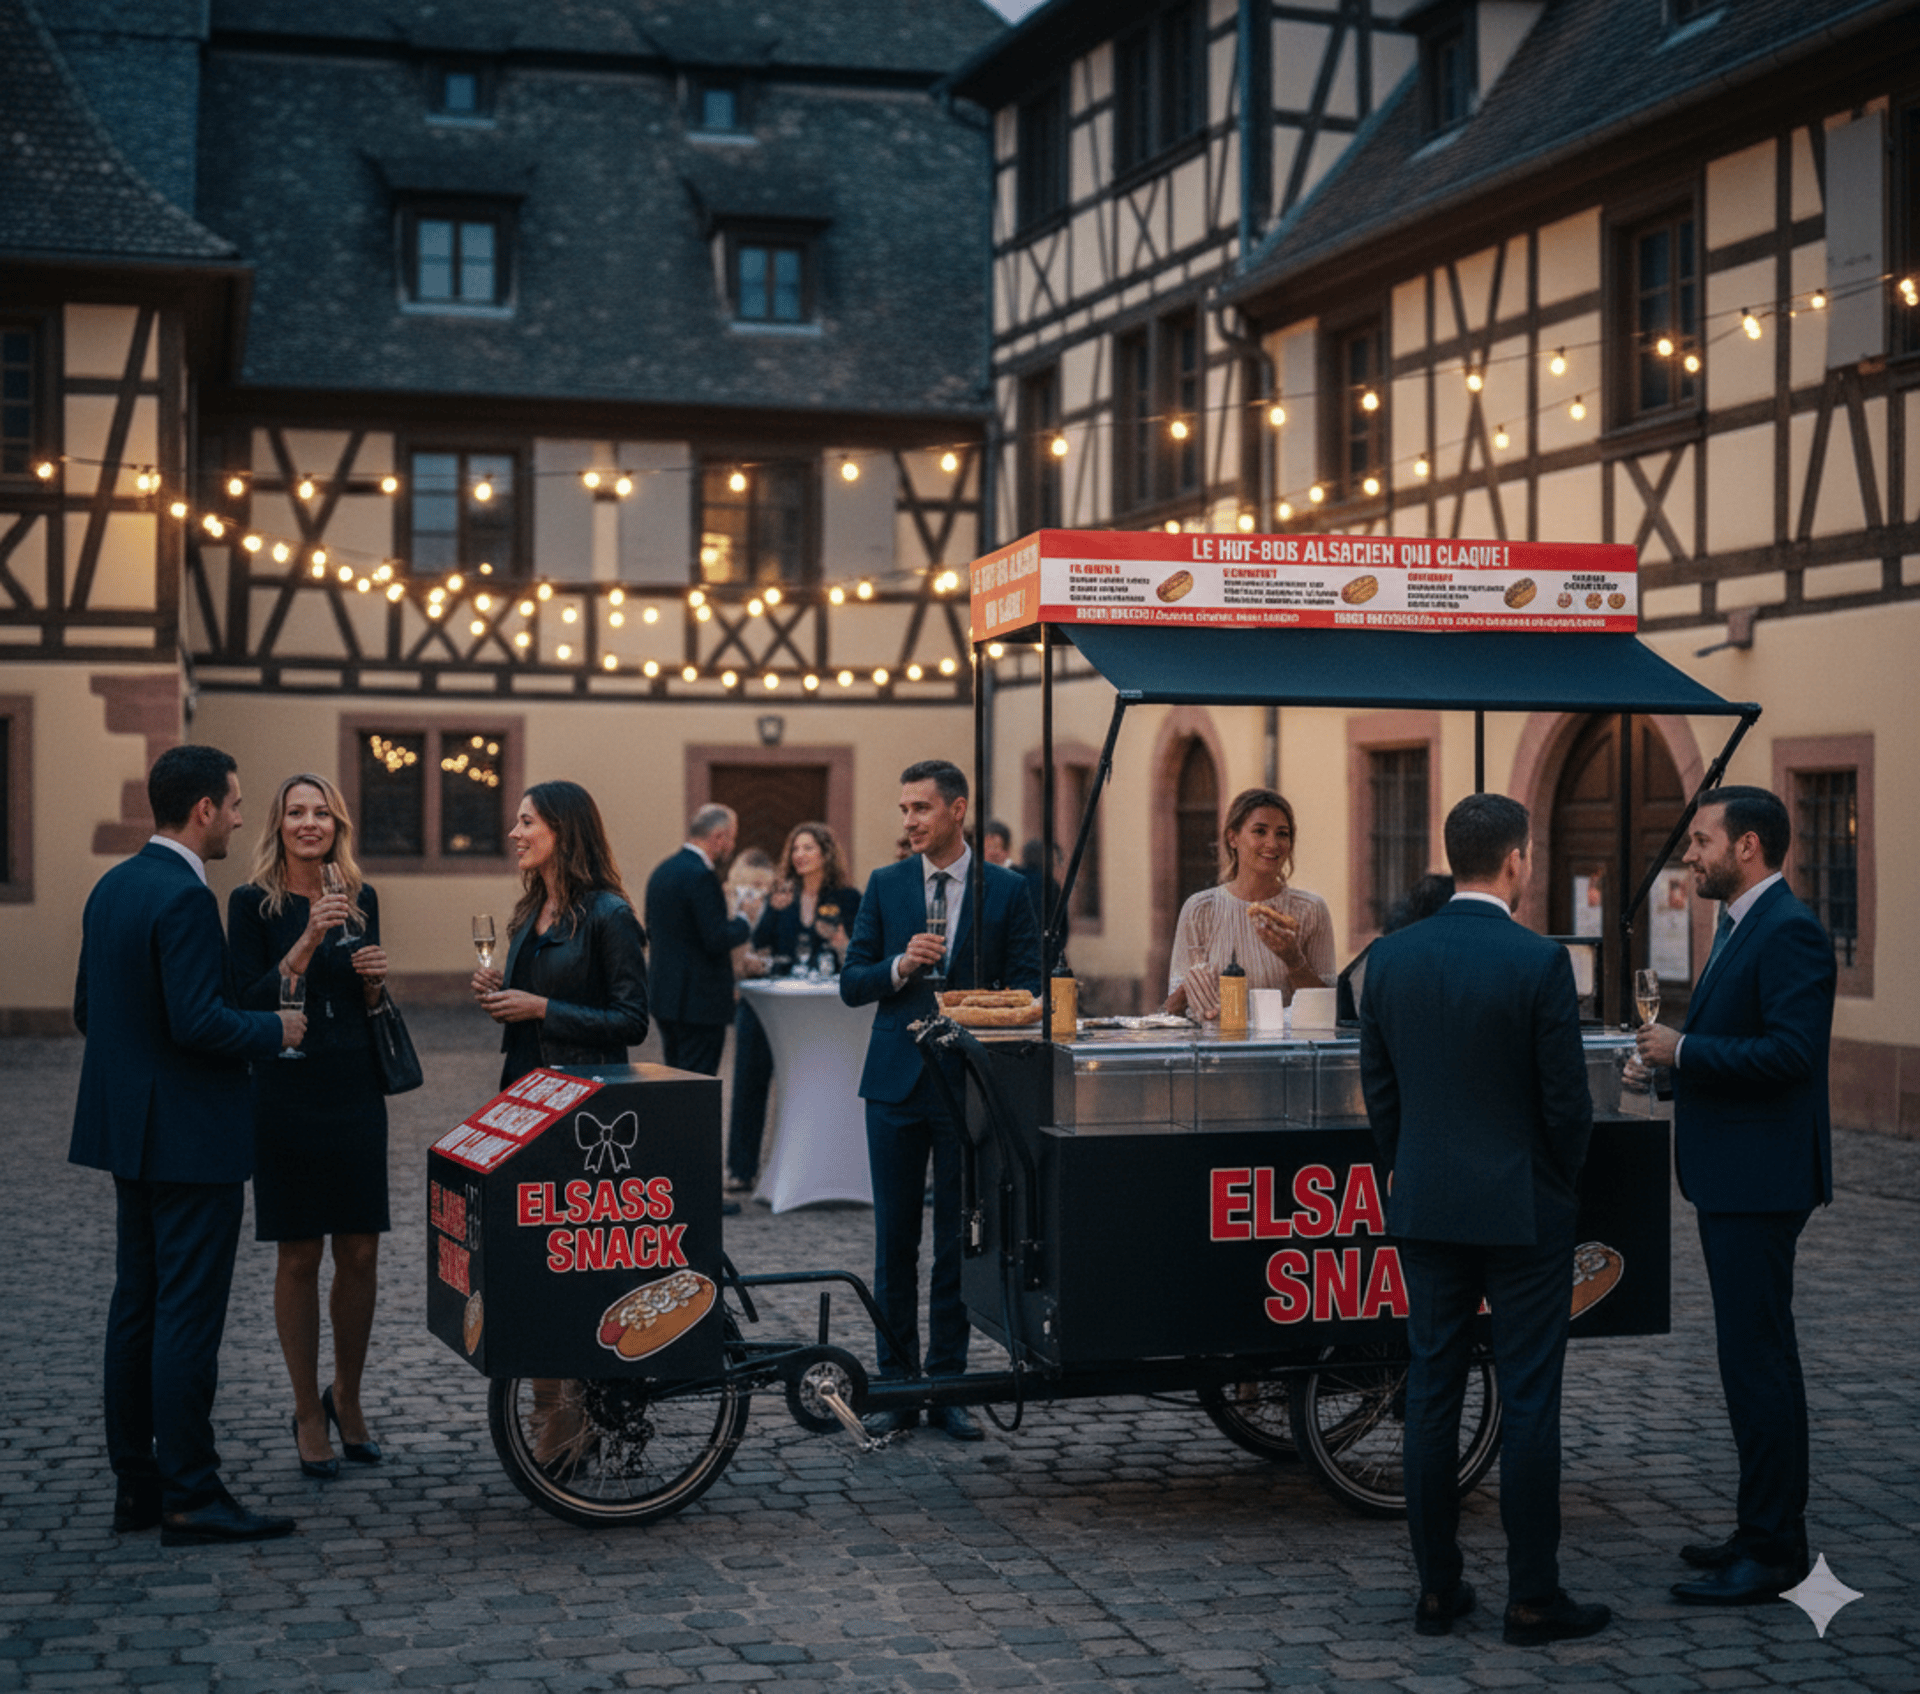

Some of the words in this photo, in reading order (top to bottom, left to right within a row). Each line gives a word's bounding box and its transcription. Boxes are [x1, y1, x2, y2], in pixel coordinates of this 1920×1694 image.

[1192, 537, 1213, 560] LE
[1303, 541, 1395, 564] ALSACIEN
[517, 1176, 674, 1226] ELSASS
[1210, 1163, 1394, 1241] ELSA
[547, 1224, 689, 1272] SNACK
[1265, 1246, 1492, 1323] SNA
